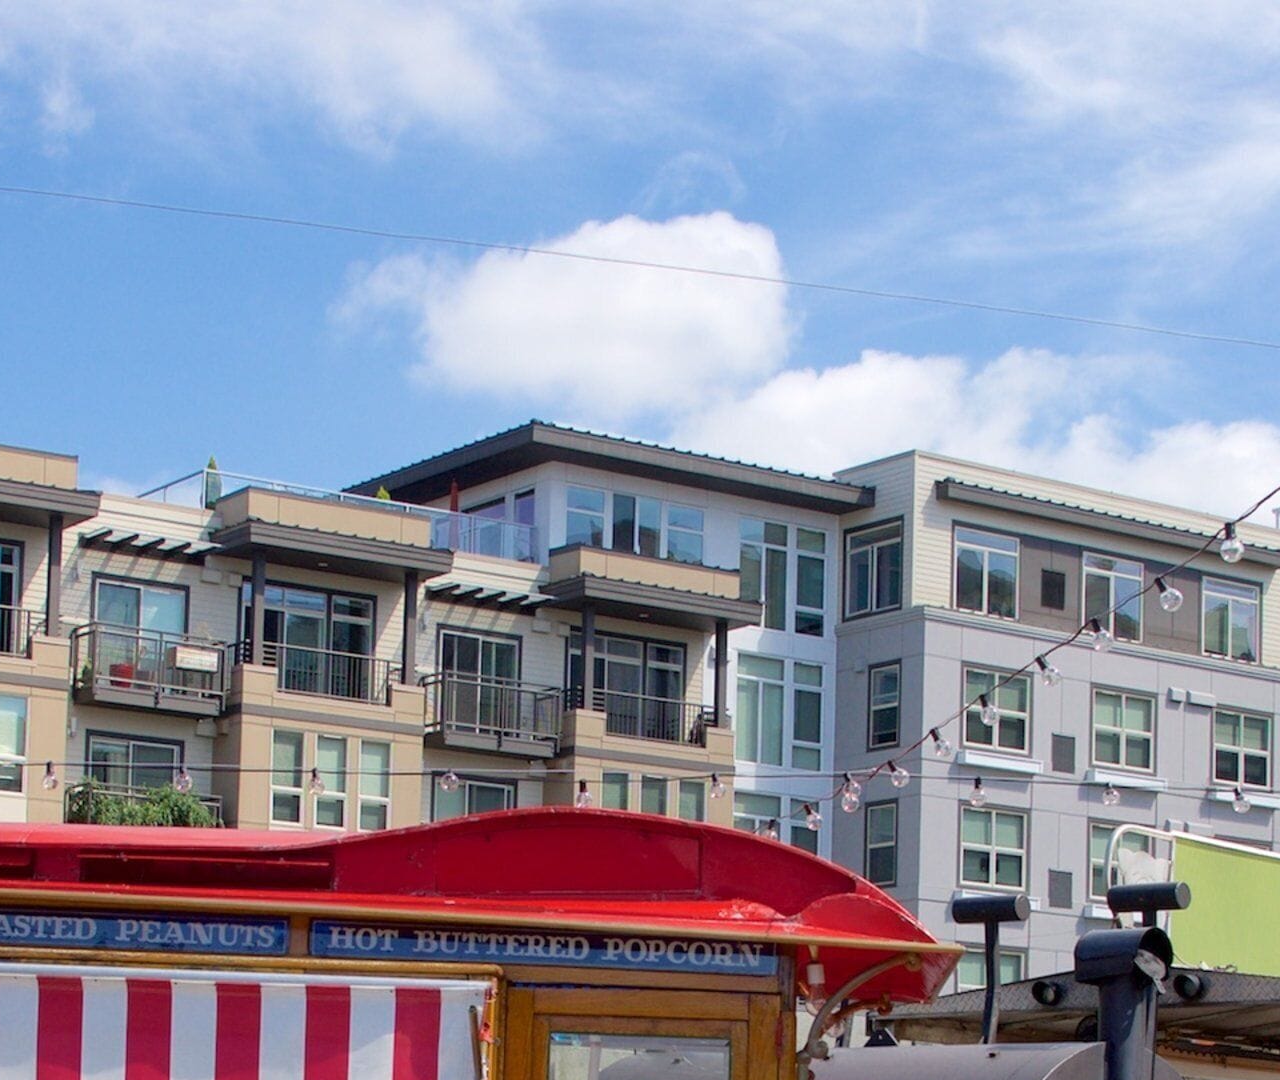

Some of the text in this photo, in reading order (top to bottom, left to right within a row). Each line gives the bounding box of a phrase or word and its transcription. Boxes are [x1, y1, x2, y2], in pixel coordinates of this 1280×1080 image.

[115, 917, 276, 948] PEANUTS
[327, 926, 763, 968] HOT BUTTERED POPCORN
